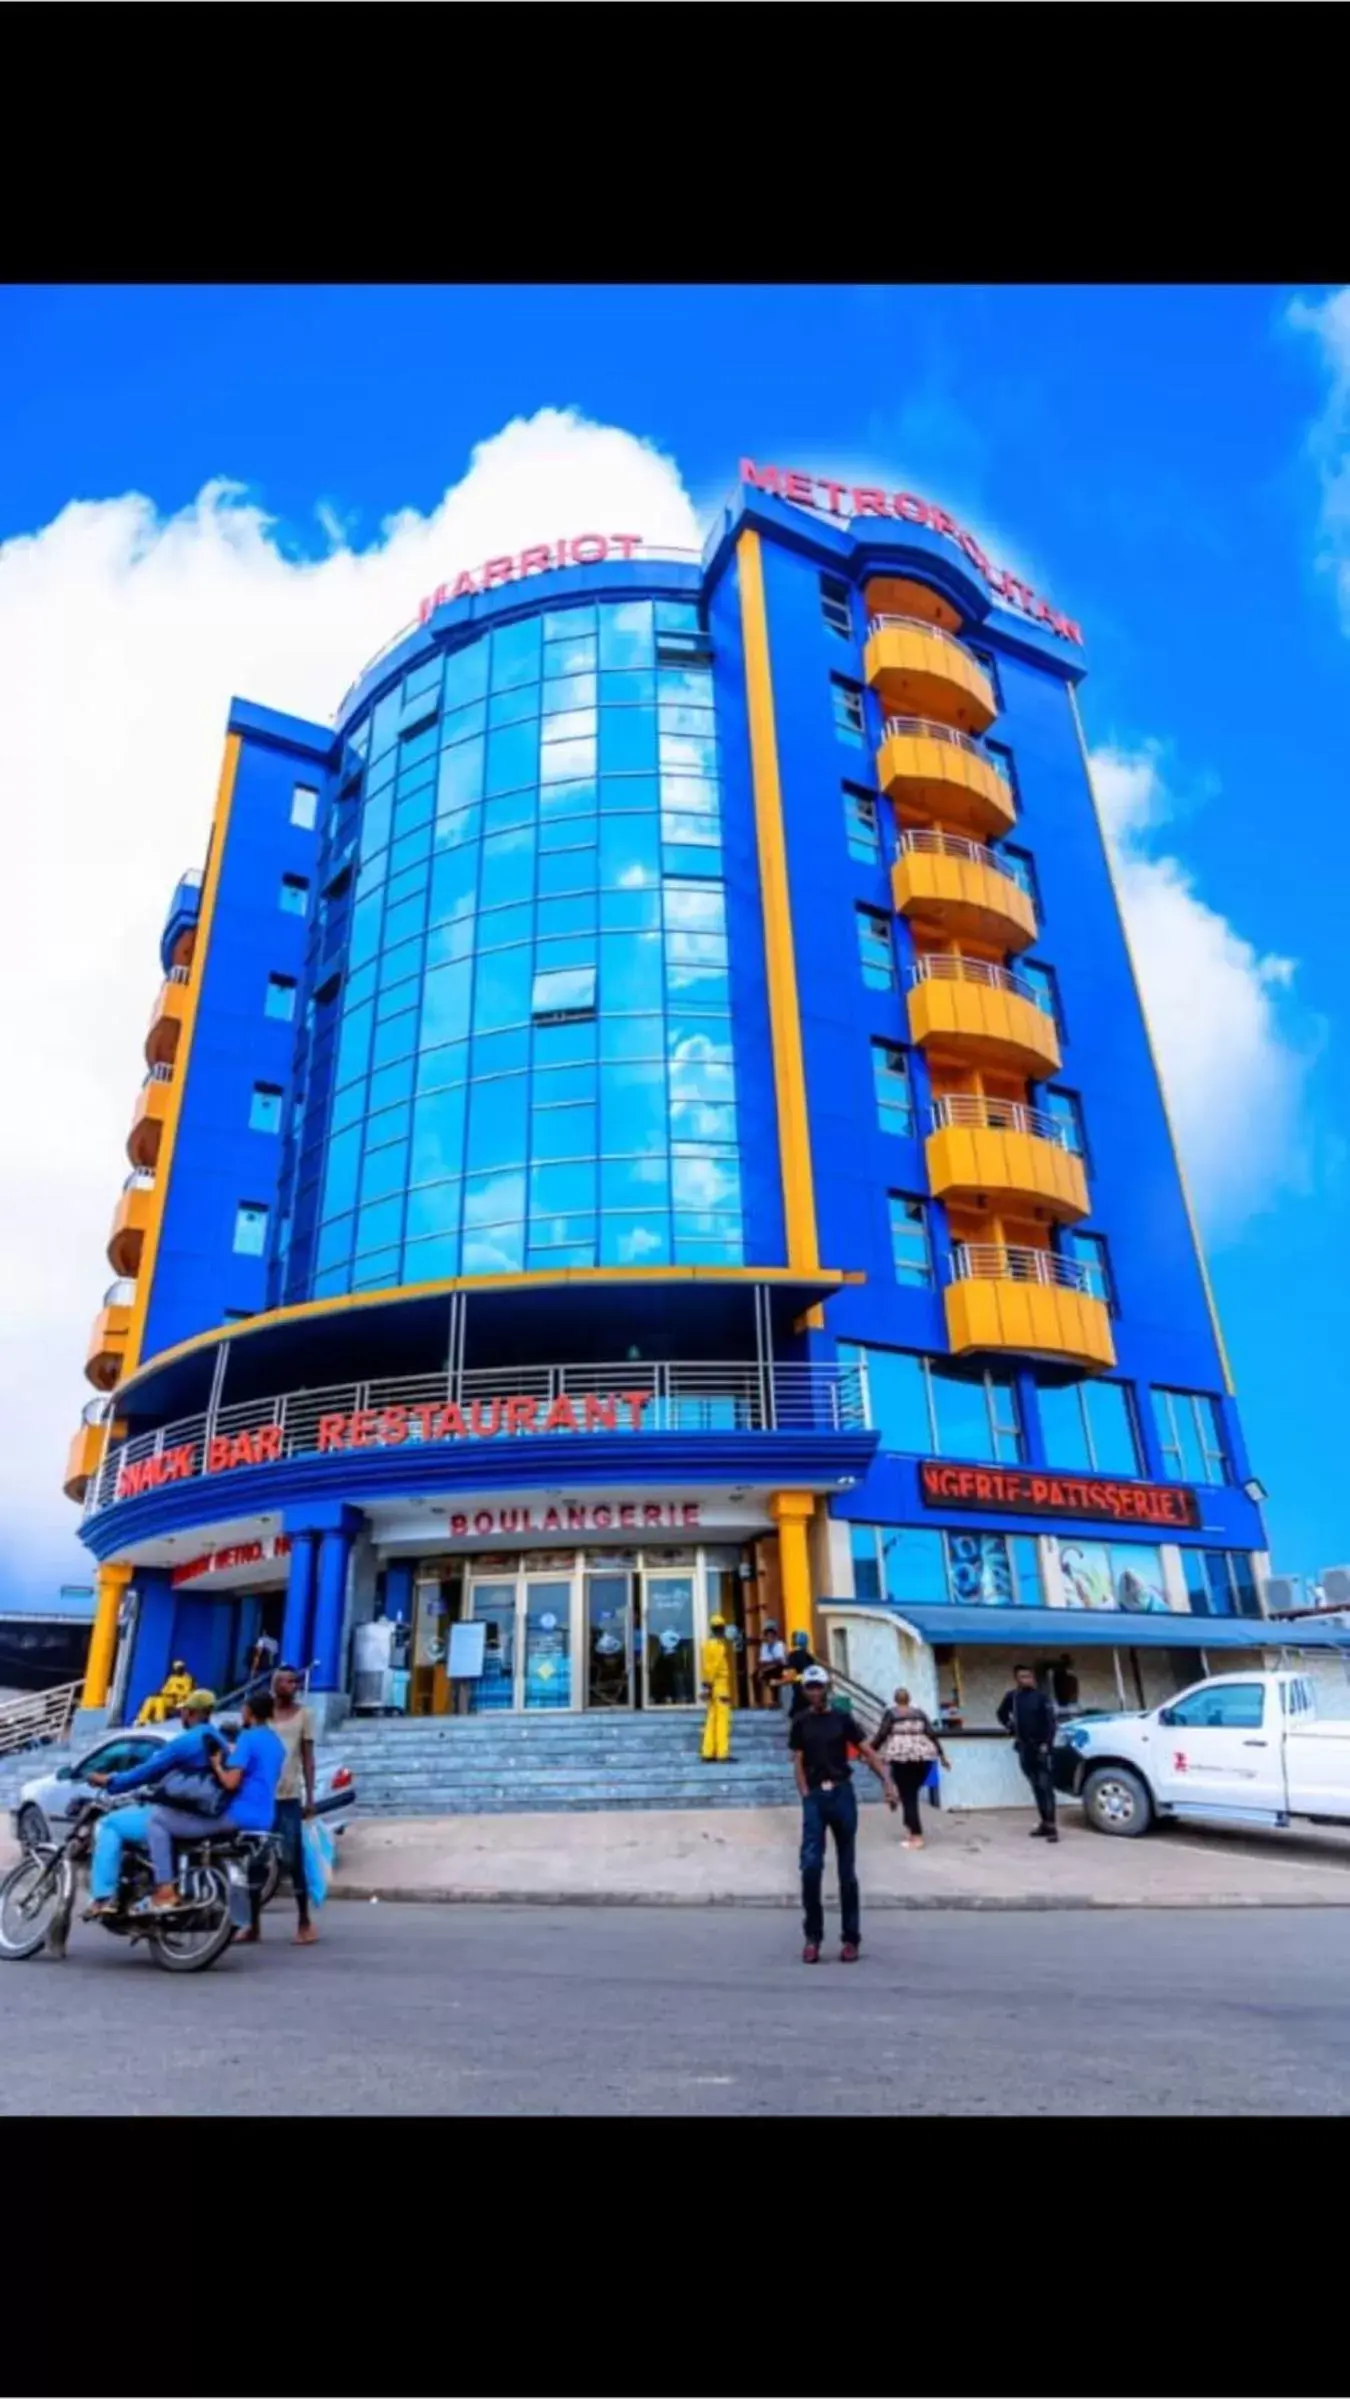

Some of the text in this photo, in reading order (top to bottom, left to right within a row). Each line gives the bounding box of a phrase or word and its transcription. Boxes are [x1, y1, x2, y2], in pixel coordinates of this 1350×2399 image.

[739, 457, 1083, 646] METROPOLITAN
[117, 1390, 651, 1498] SNACK BAR RESTAURANT
[449, 1503, 700, 1536] BOULANGERIE
